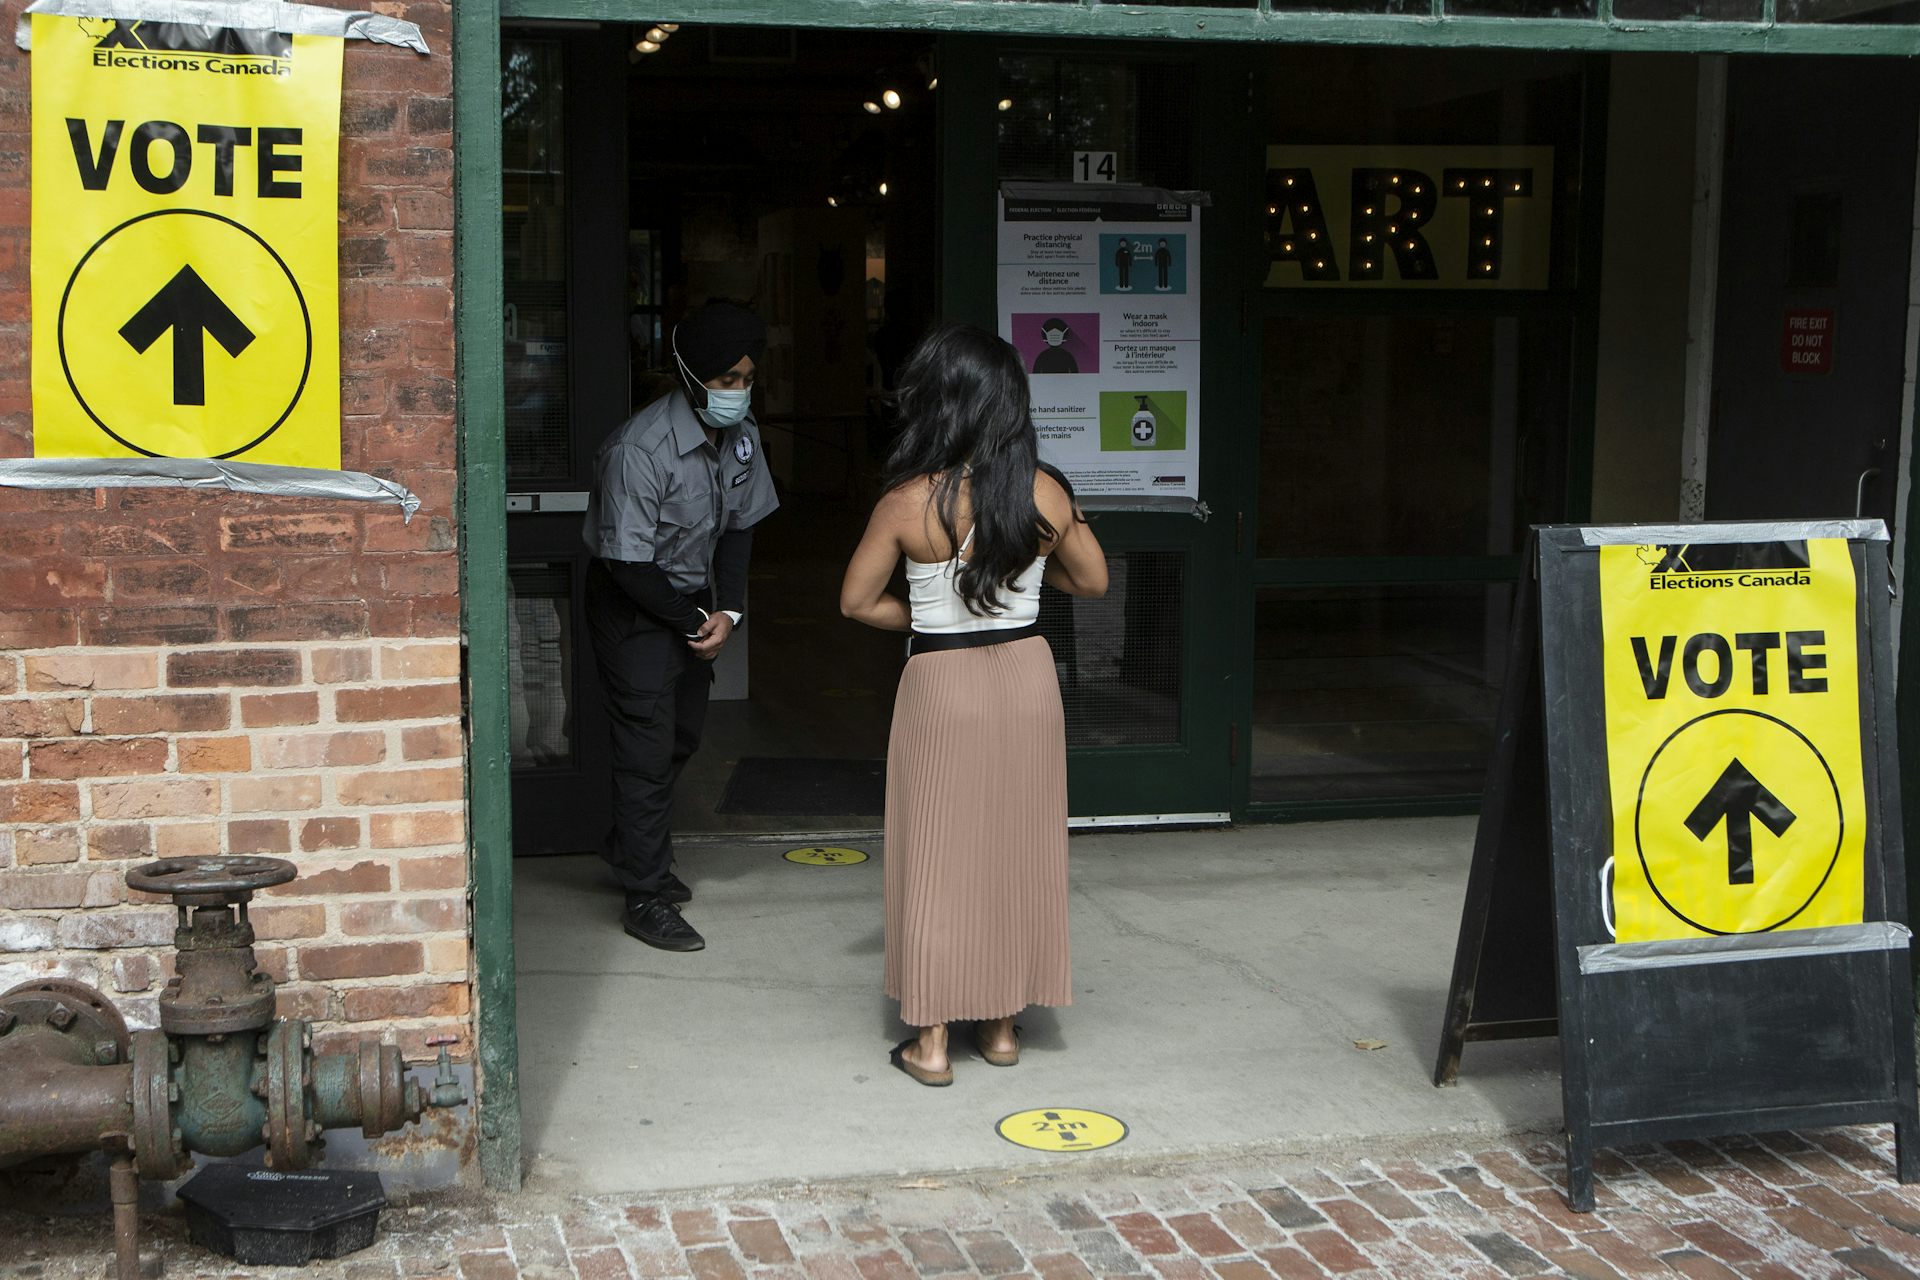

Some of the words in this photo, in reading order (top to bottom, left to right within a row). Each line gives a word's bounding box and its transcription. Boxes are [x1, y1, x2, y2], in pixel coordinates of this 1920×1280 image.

[93, 52, 200, 72] Elections
[205, 57, 292, 77] Canada
[65, 117, 302, 198] VOTE
[1078, 153, 1116, 181] 14
[1262, 168, 1533, 280] ART
[1054, 234, 1083, 243] physical
[1133, 241, 1152, 253] 2m
[1790, 316, 1808, 329] FIRE
[1809, 317, 1828, 329] EXIT
[1792, 334, 1804, 346] DO
[1805, 334, 1823, 347] NOT
[1792, 352, 1820, 364] BLOCK
[1649, 576, 1733, 590] Elections
[1738, 572, 1811, 588] Canada
[1630, 630, 1828, 700] VOTE
[1032, 1122, 1088, 1132] 2m
